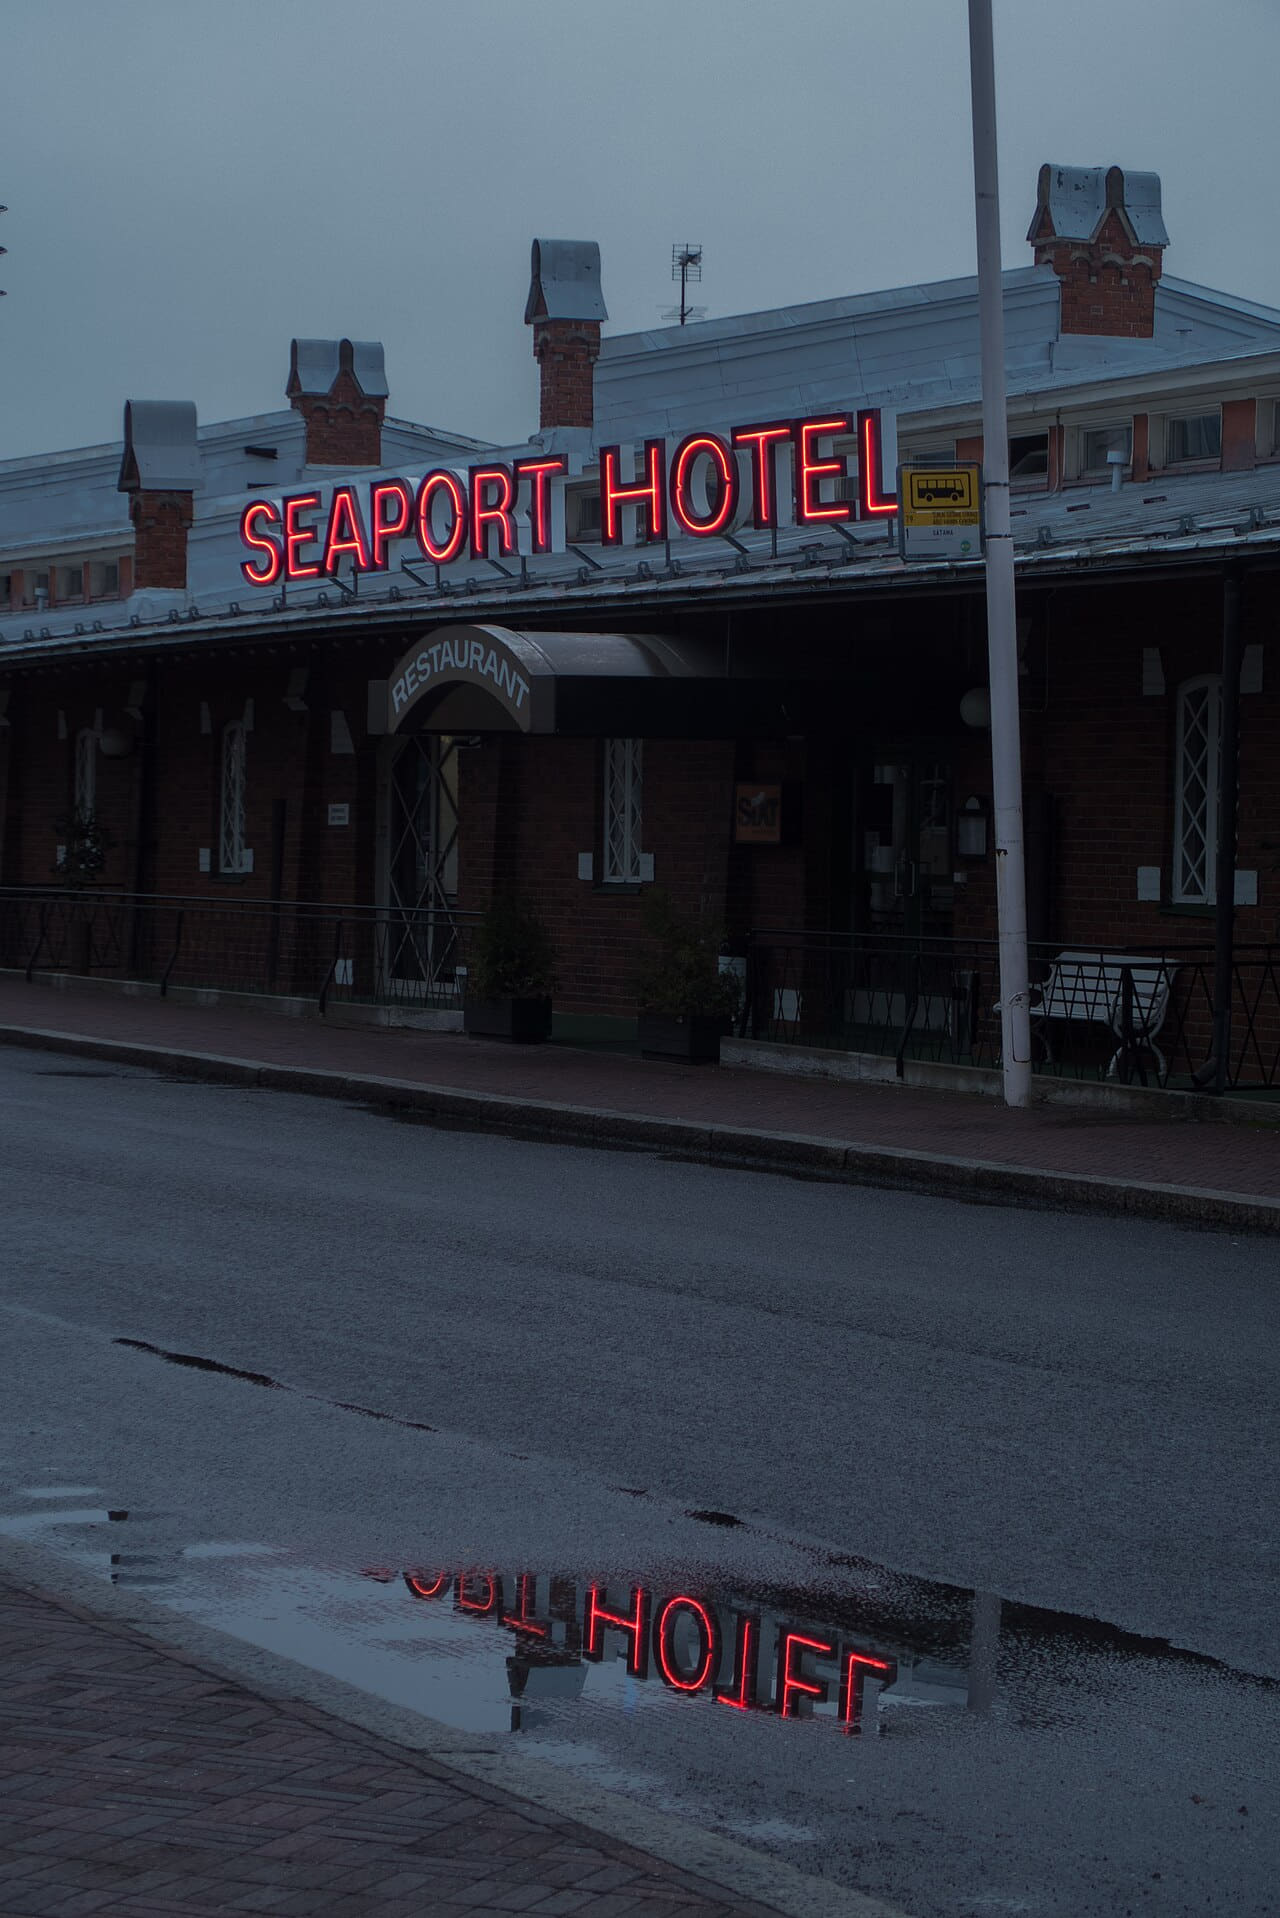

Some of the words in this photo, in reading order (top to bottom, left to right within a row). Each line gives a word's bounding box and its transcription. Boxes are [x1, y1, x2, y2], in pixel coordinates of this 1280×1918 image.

[239, 454, 567, 587] SEAPORT
[600, 408, 898, 545] HOTEL
[391, 639, 530, 714] RESTAURANT
